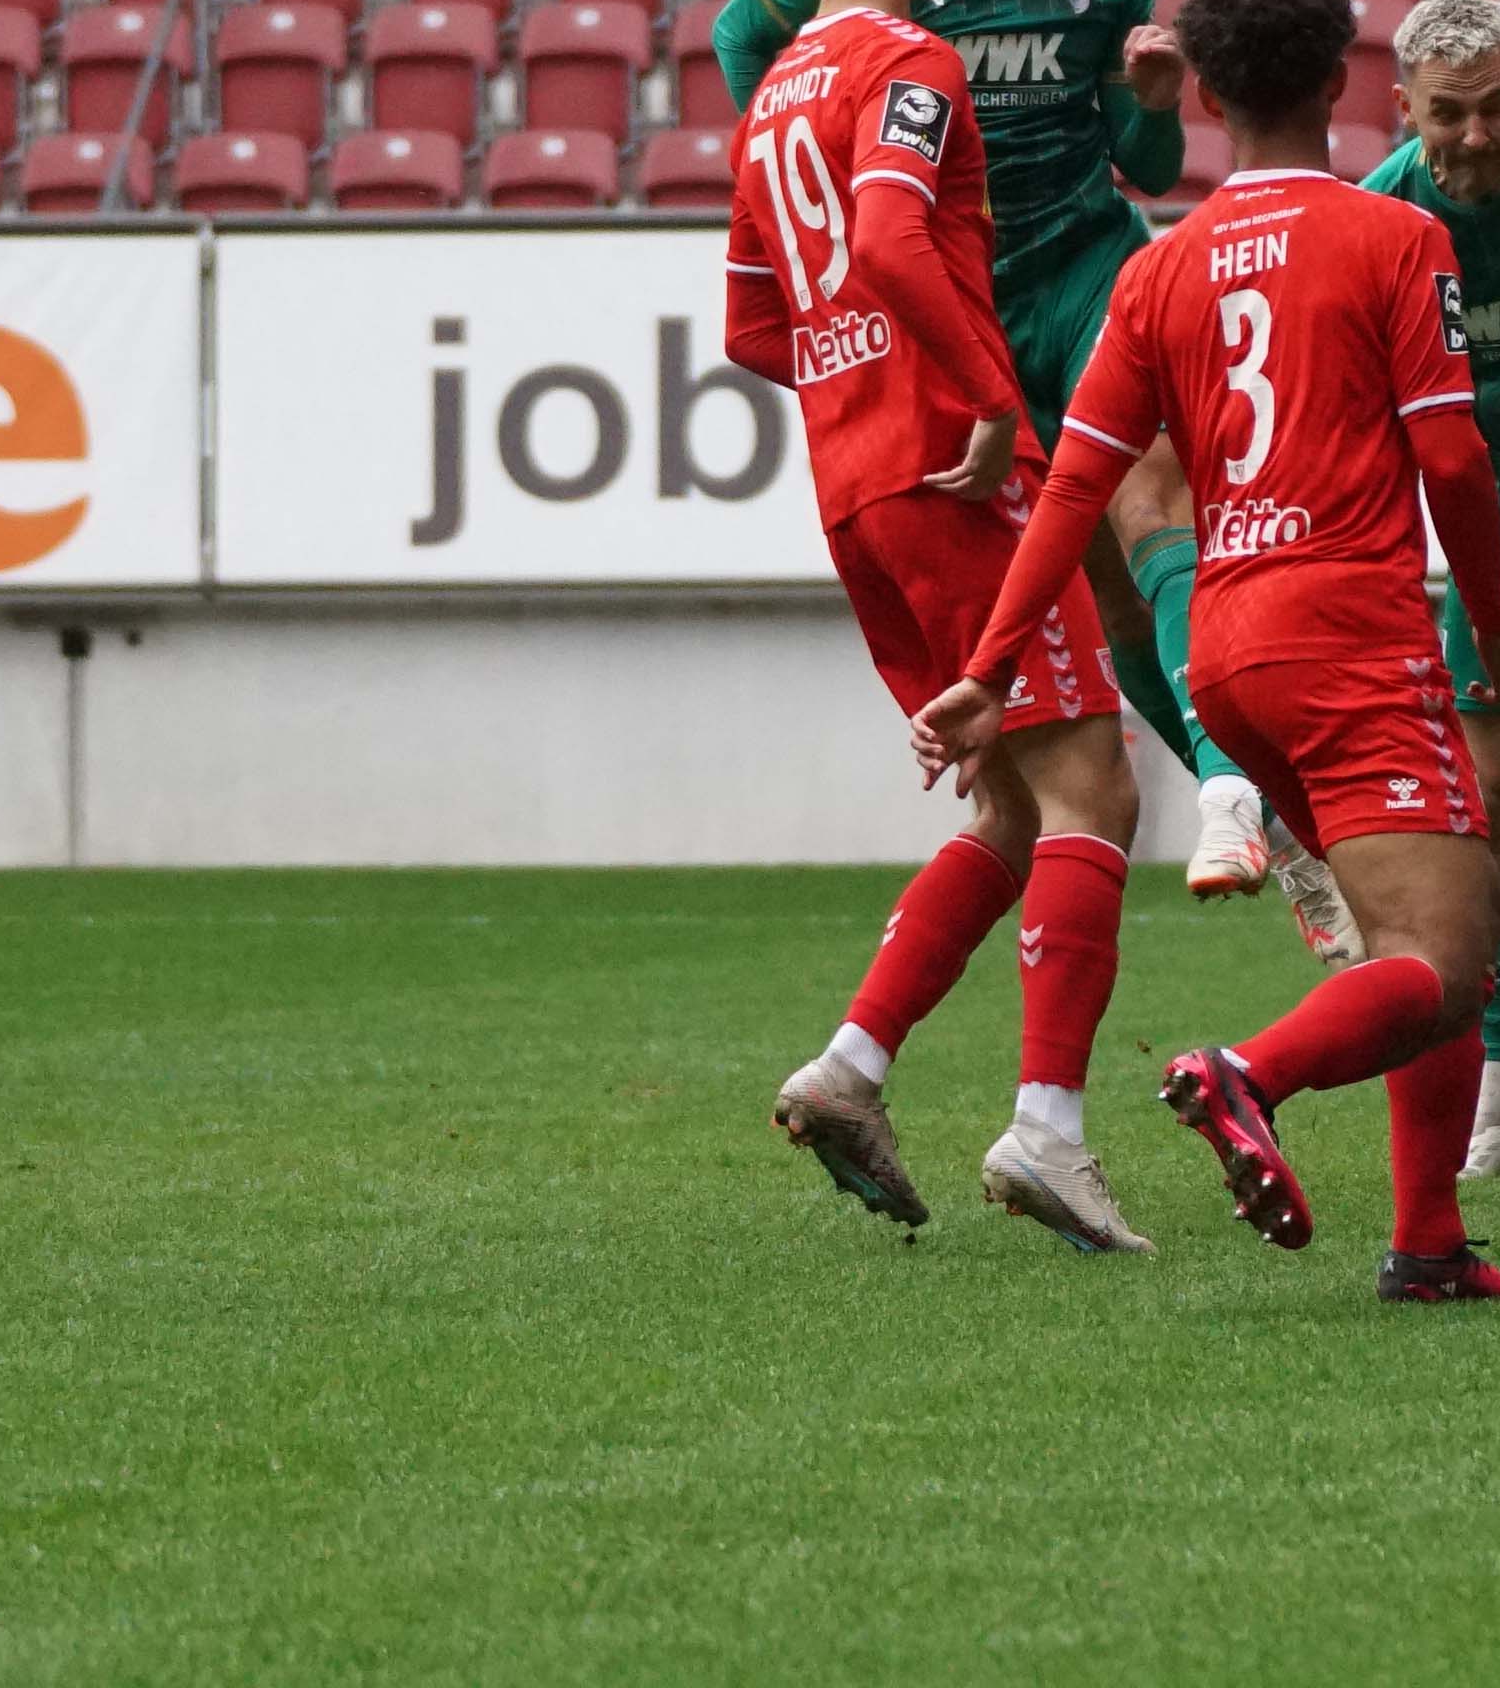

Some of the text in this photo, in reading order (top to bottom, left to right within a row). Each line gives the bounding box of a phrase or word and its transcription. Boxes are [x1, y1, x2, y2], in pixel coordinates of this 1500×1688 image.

[968, 91, 1068, 108] ICHERUNGEN
[886, 124, 936, 158] bwin
[749, 115, 850, 312] 19
[1210, 230, 1289, 282] HEIN
[792, 312, 891, 384] Netto
[1219, 288, 1275, 485] 3
[1202, 498, 1311, 562] Netto
